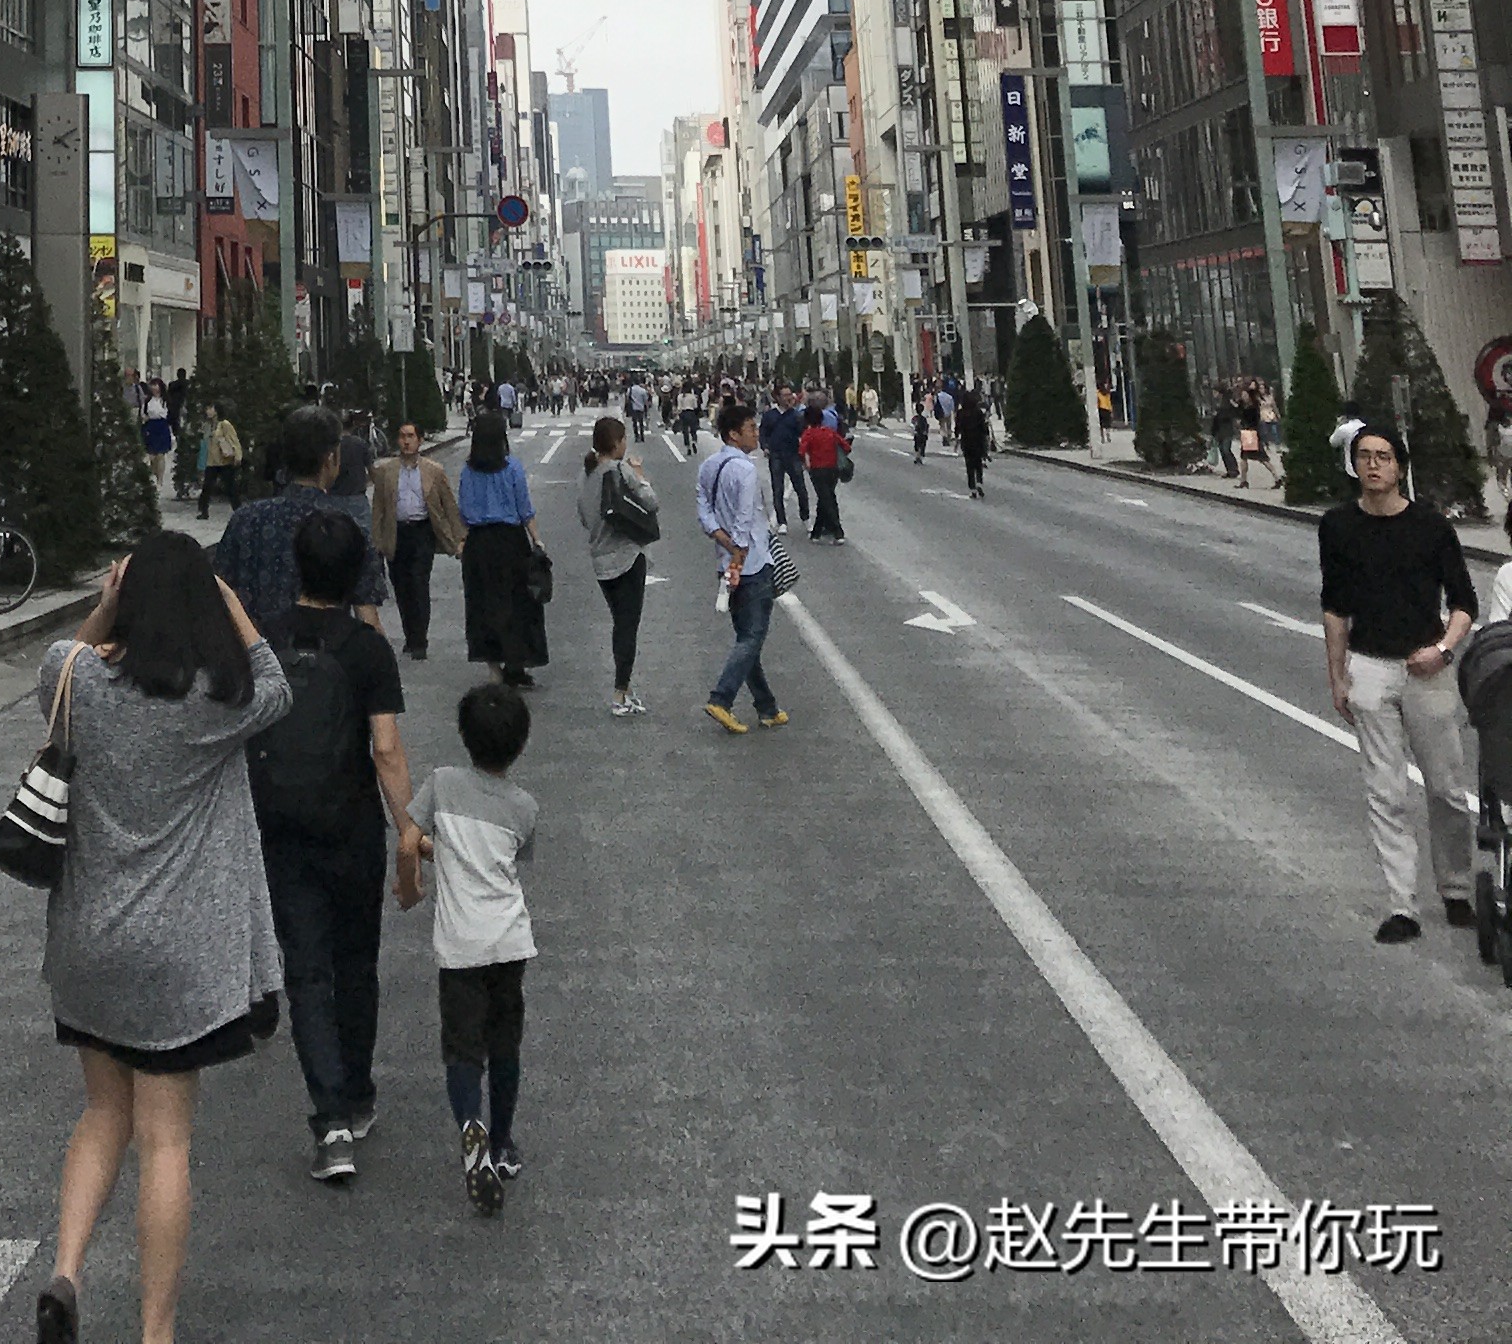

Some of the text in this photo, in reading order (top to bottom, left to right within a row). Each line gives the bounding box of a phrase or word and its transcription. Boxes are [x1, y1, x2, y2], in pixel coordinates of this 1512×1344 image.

[1007, 91, 1029, 181] 日新堂
[620, 255, 658, 268] LIXIL
